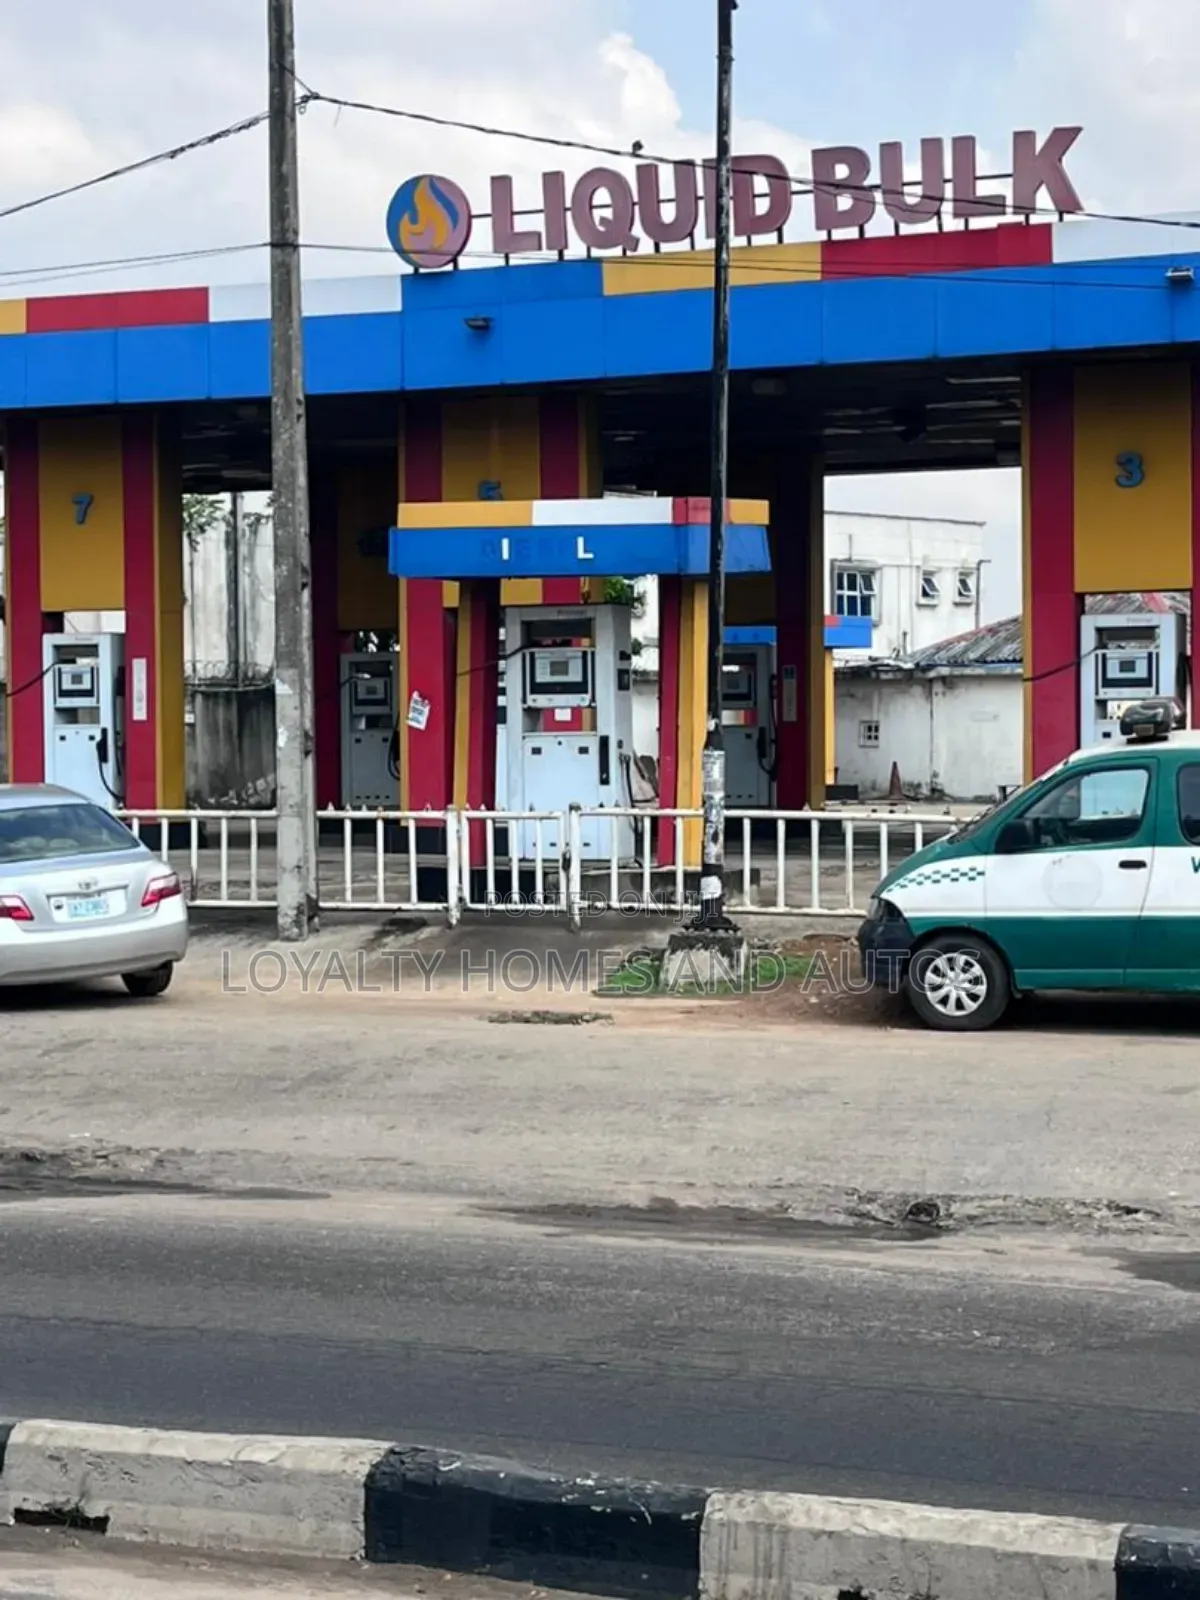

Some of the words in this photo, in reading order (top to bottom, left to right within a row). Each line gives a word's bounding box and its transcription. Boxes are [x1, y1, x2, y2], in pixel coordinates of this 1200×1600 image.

[490, 154, 792, 253] LIQUID
[811, 126, 1085, 231] BULK
[1115, 451, 1145, 489] 3
[71, 491, 94, 525] 7
